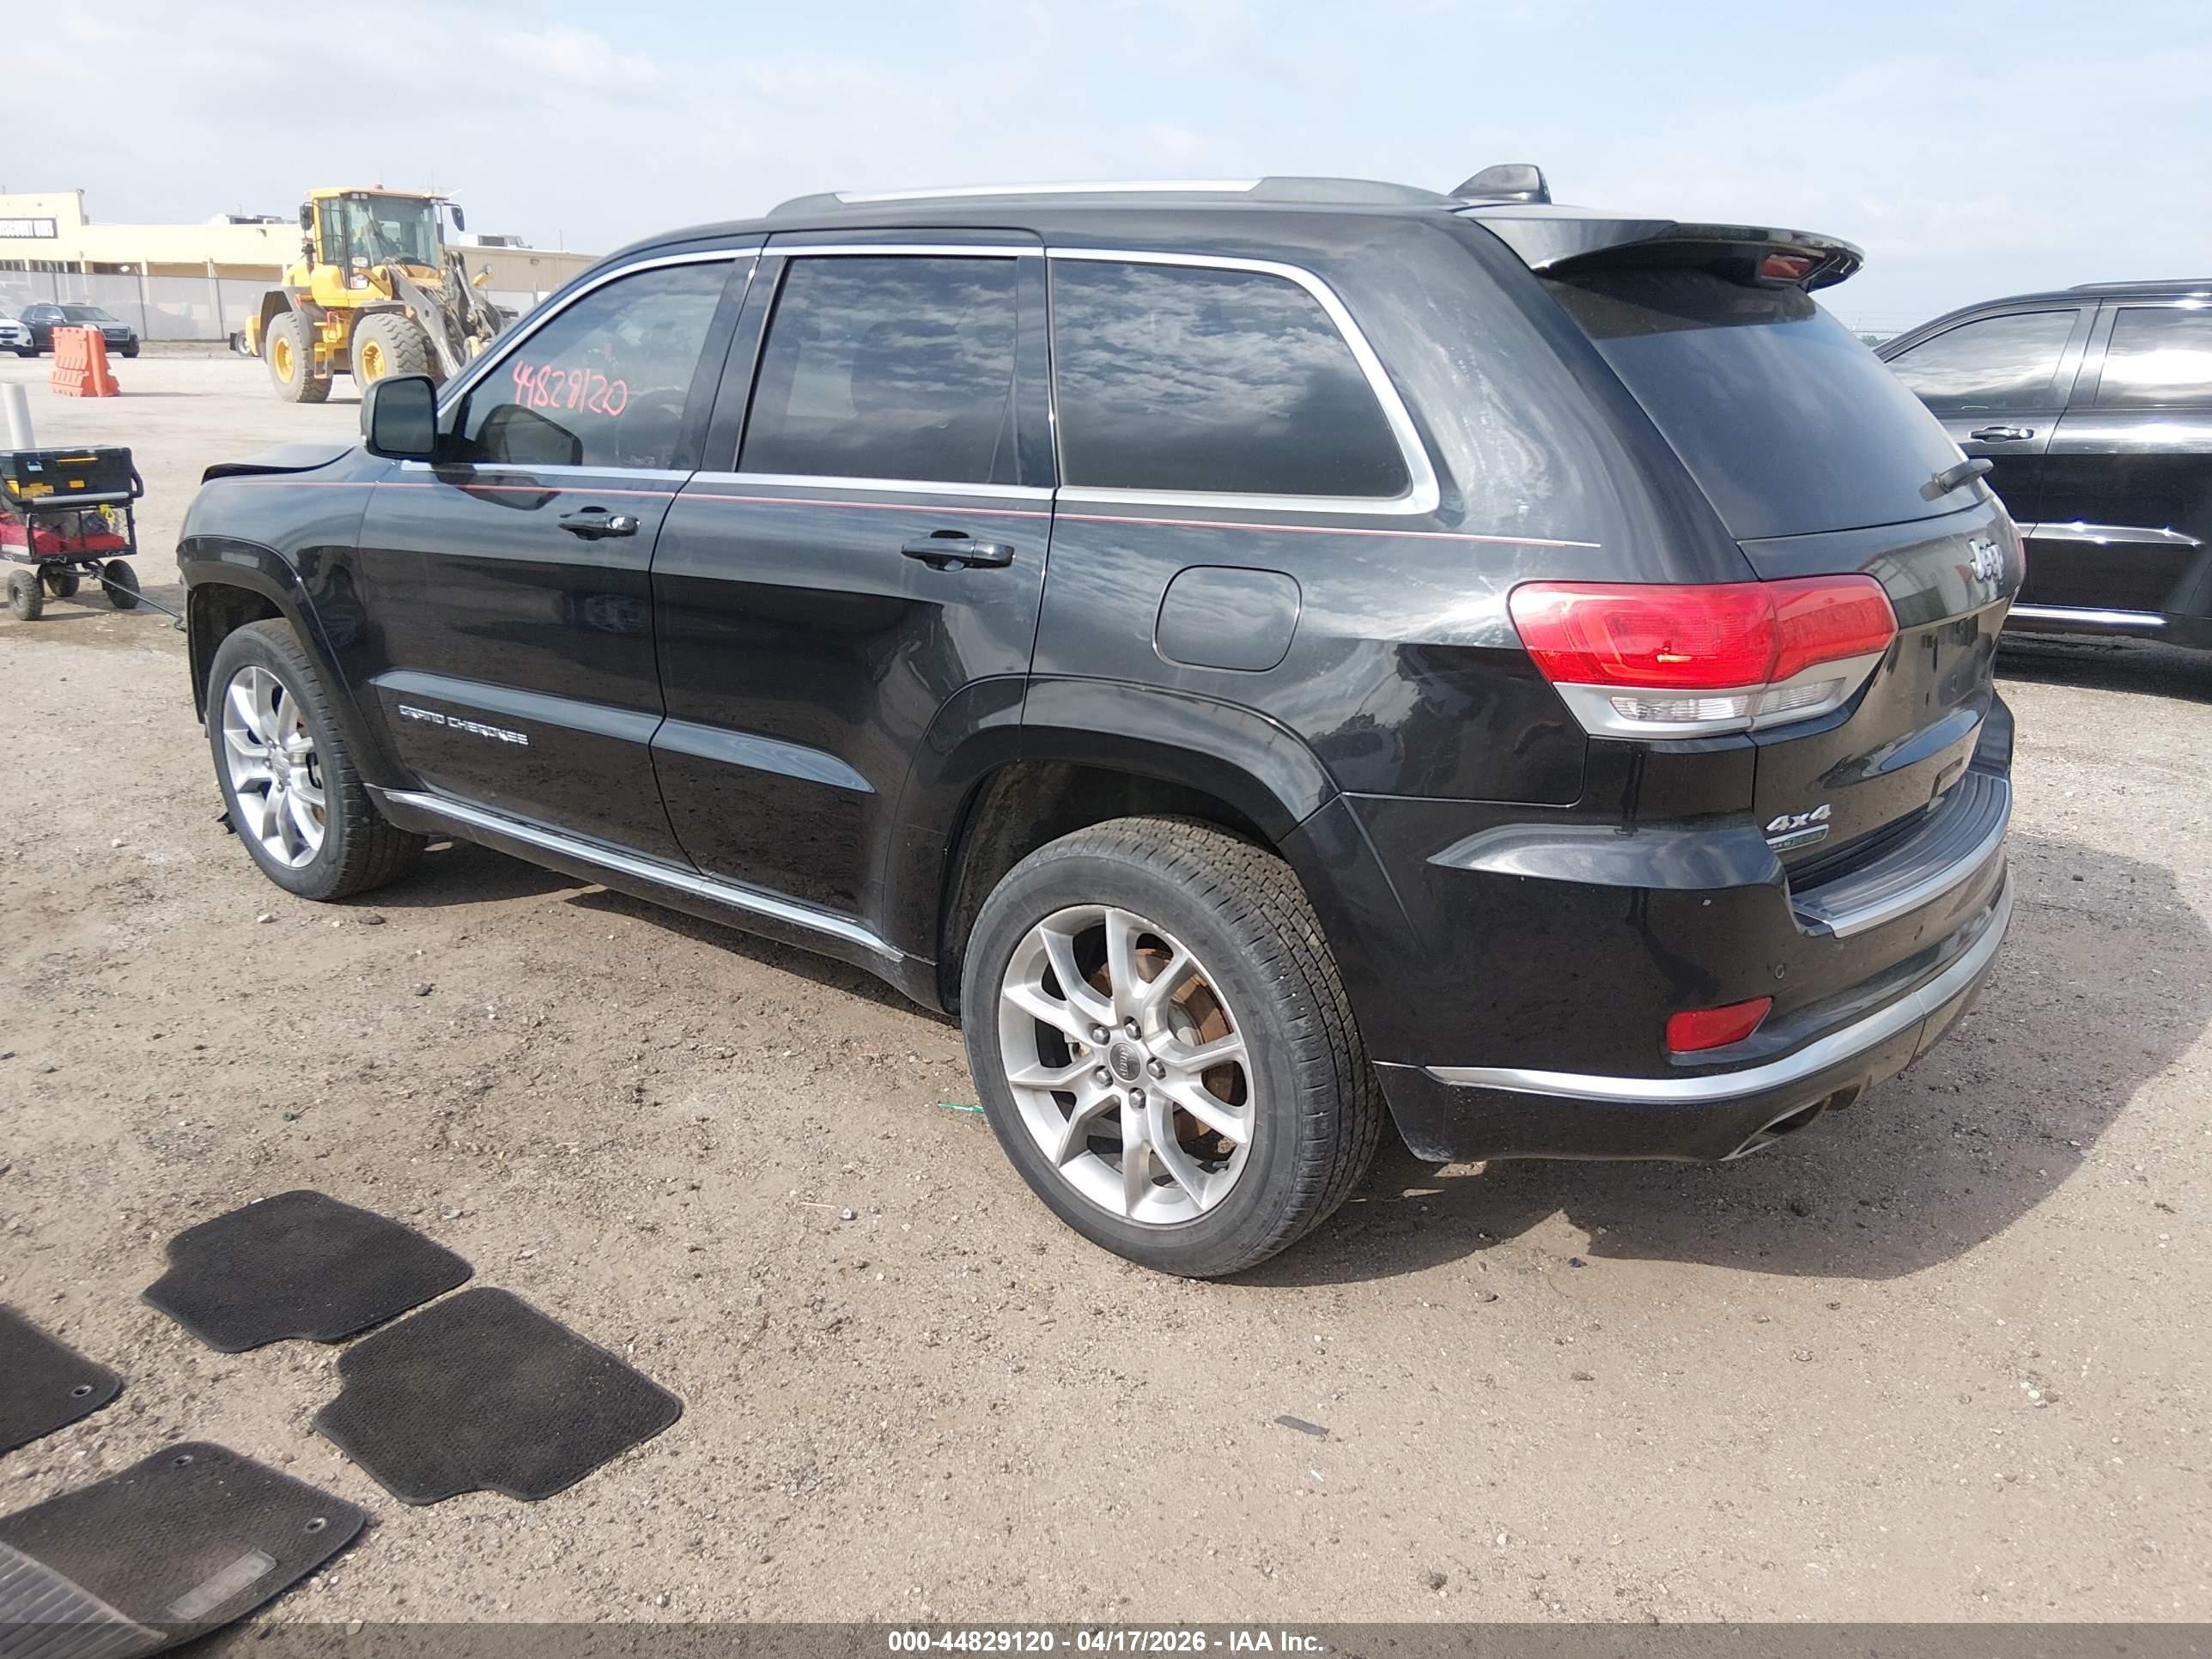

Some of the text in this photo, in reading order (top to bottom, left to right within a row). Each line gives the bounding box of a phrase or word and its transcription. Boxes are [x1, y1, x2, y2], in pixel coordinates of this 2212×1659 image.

[513, 360, 628, 416] 44829120
[1969, 541, 2004, 580] Jeep
[1765, 804, 1832, 831] 4x4
